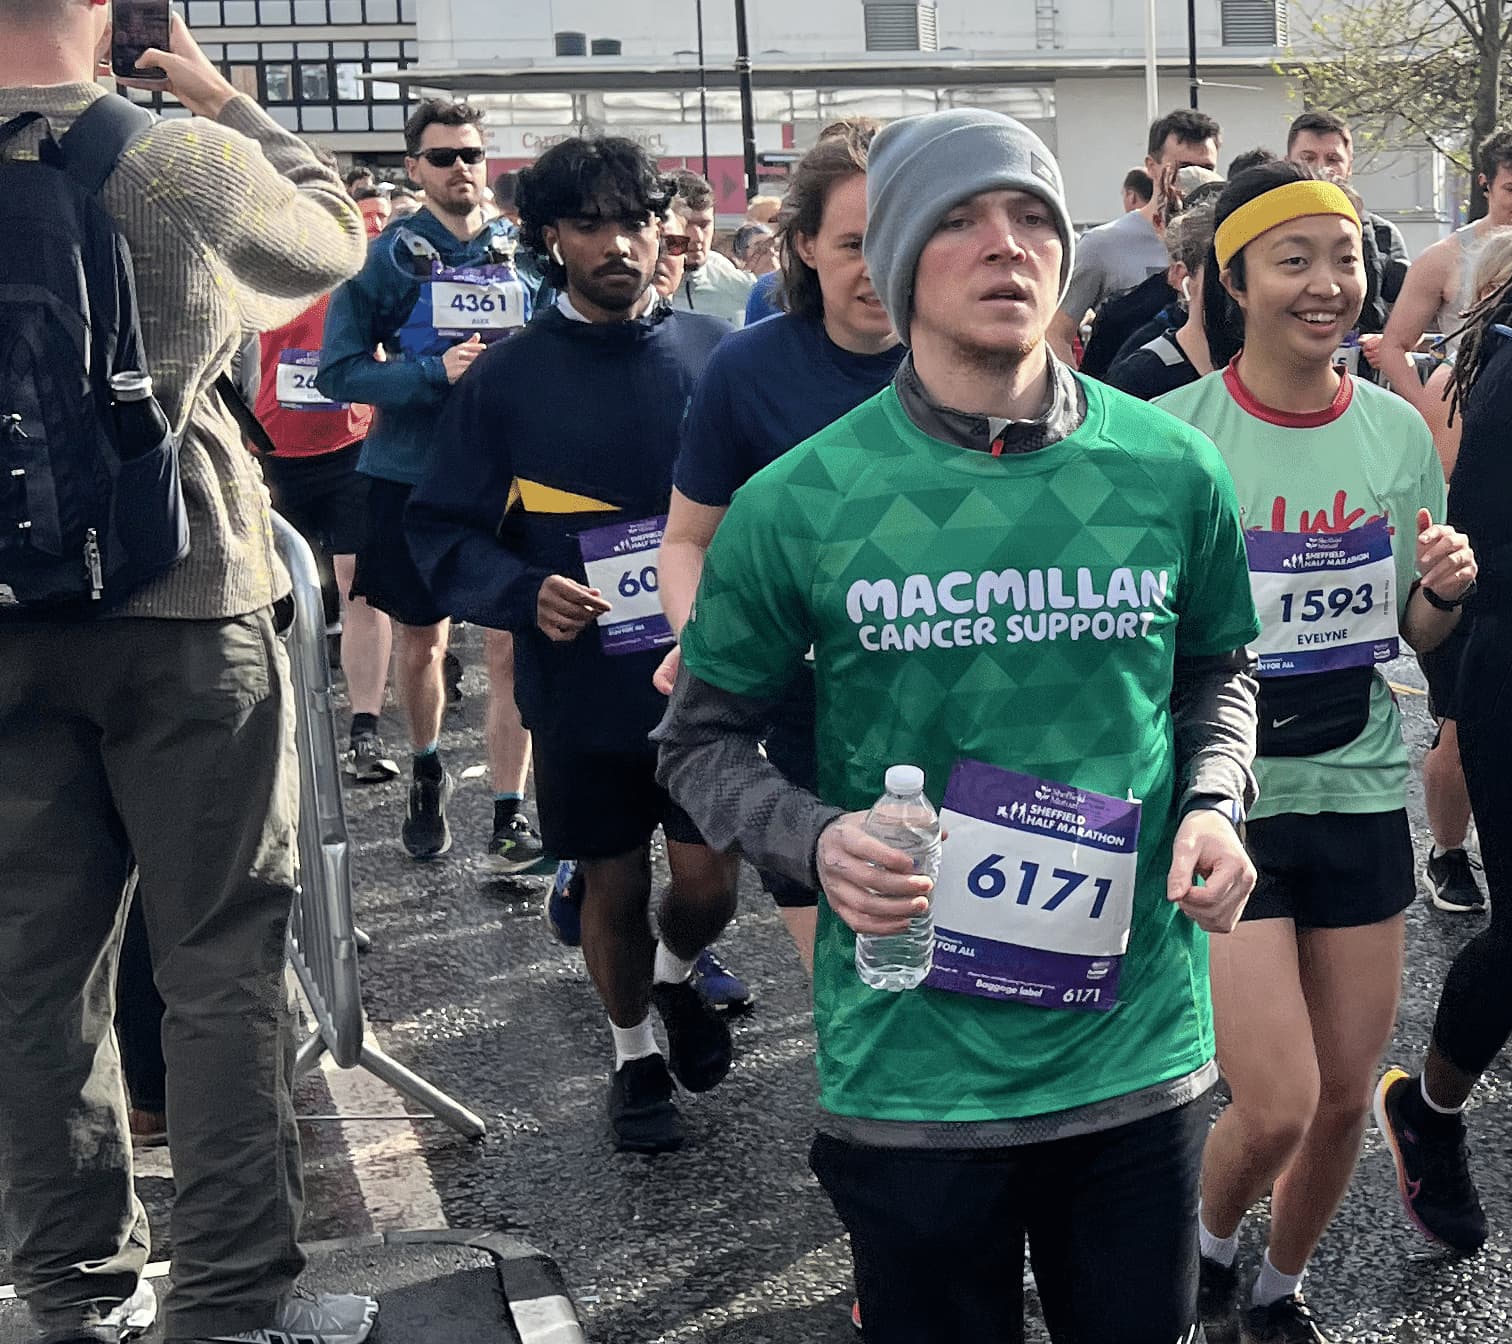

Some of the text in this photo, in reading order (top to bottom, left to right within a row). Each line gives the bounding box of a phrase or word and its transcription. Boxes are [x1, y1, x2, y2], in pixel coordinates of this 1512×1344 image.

[451, 293, 507, 312] 4361
[846, 567, 1169, 623] MACMILLAN
[1280, 583, 1374, 623] 1593
[859, 611, 1156, 651] CANCER SUPPORT
[1297, 629, 1348, 645] EVELYNE
[1029, 804, 1086, 825] SHEFFIELD
[1027, 815, 1125, 846] HALF MARATHON
[967, 853, 1113, 919] 6171
[937, 940, 976, 957] FOR ALL
[975, 979, 1018, 996] Baggage
[1019, 986, 1044, 998] label
[1062, 988, 1101, 1003] 6171
